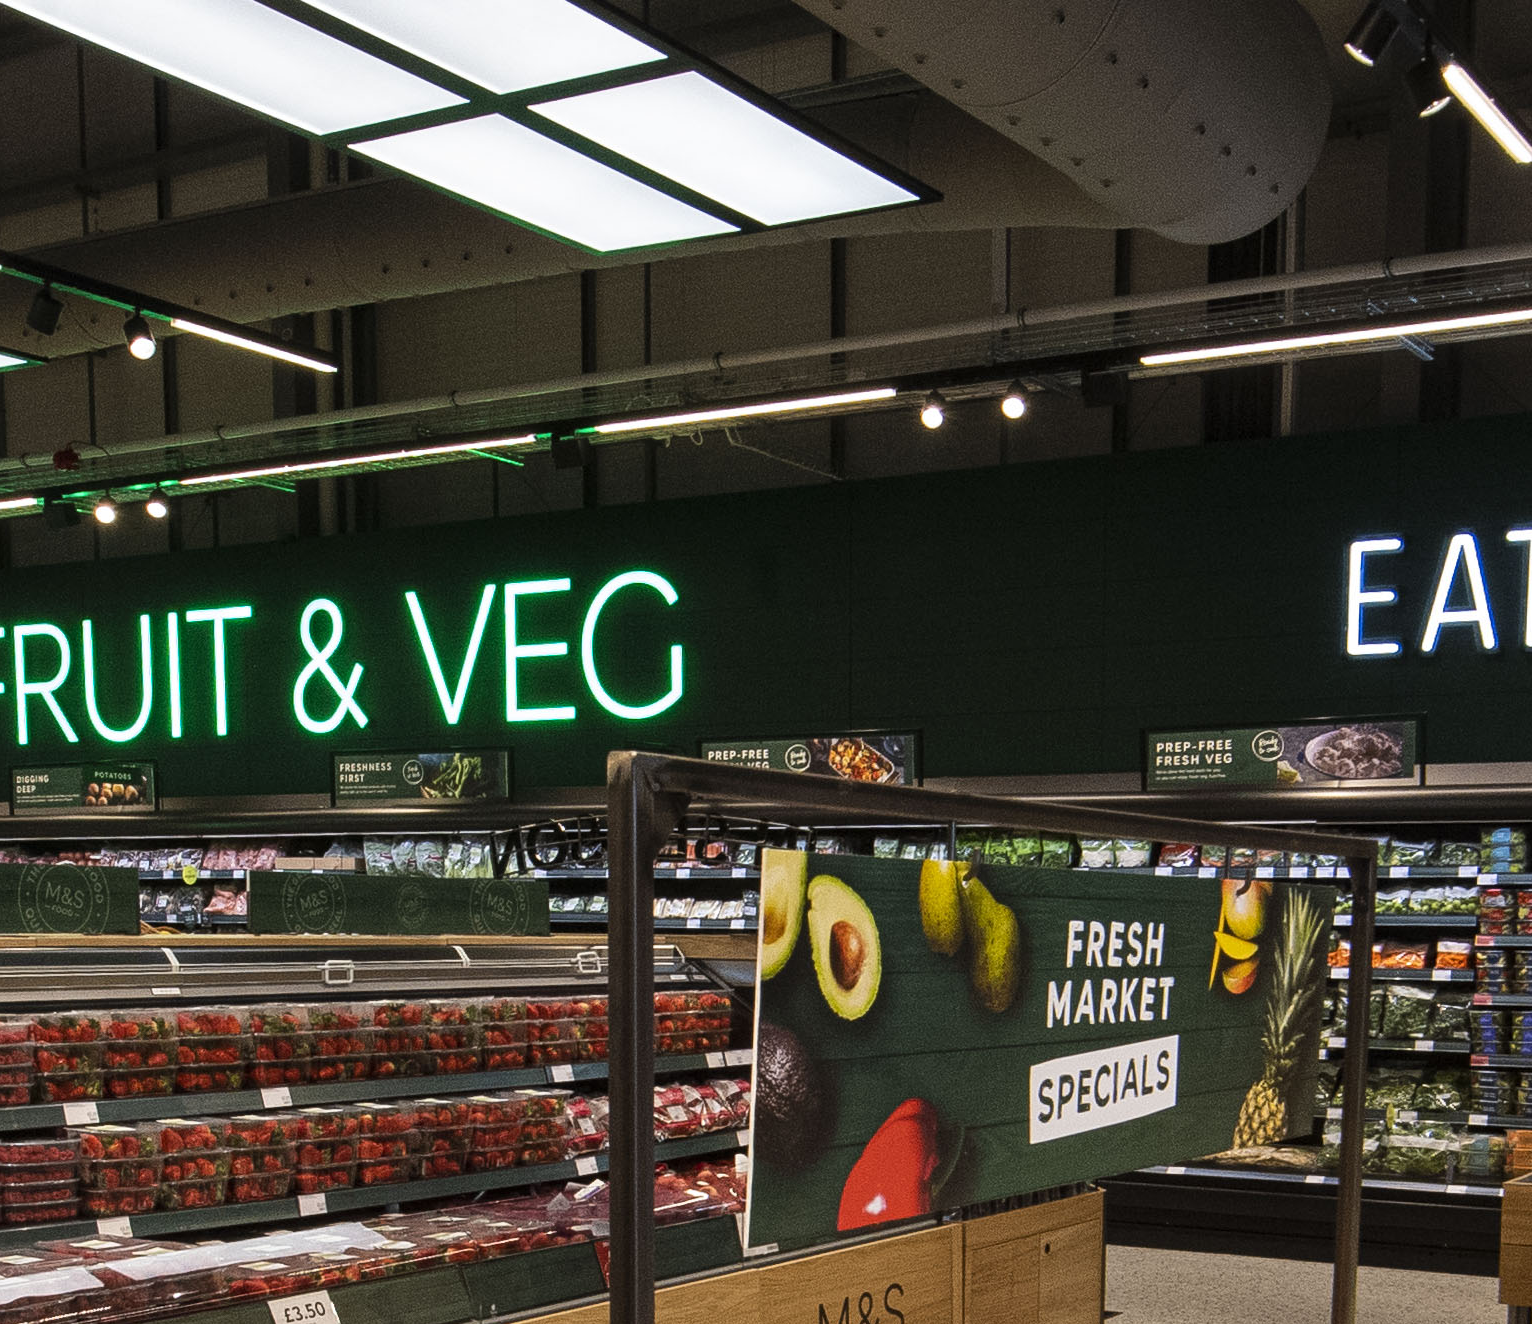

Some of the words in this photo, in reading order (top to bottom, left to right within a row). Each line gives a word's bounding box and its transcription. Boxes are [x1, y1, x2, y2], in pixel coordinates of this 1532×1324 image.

[292, 598, 369, 734] &
[405, 570, 684, 725] VEG
[1156, 739, 1233, 753] PREP-FREE
[708, 749, 769, 760] PREP-FREE
[1156, 754, 1200, 767] FRESH
[1204, 753, 1233, 764] VEG
[339, 762, 392, 772] FRESHNESS
[16, 775, 49, 784] DIGGING
[94, 771, 132, 781] POTATOES
[339, 773, 364, 783] FIRST
[16, 785, 36, 794] DEEP
[45, 881, 85, 910] M&S
[300, 892, 329, 911] M&S
[486, 895, 513, 917] M&S
[1066, 920, 1165, 968] FRESH
[1046, 976, 1175, 1029] MARKET
[1037, 1050, 1171, 1125] SPECIALS
[283, 1301, 326, 1324] £3.50
